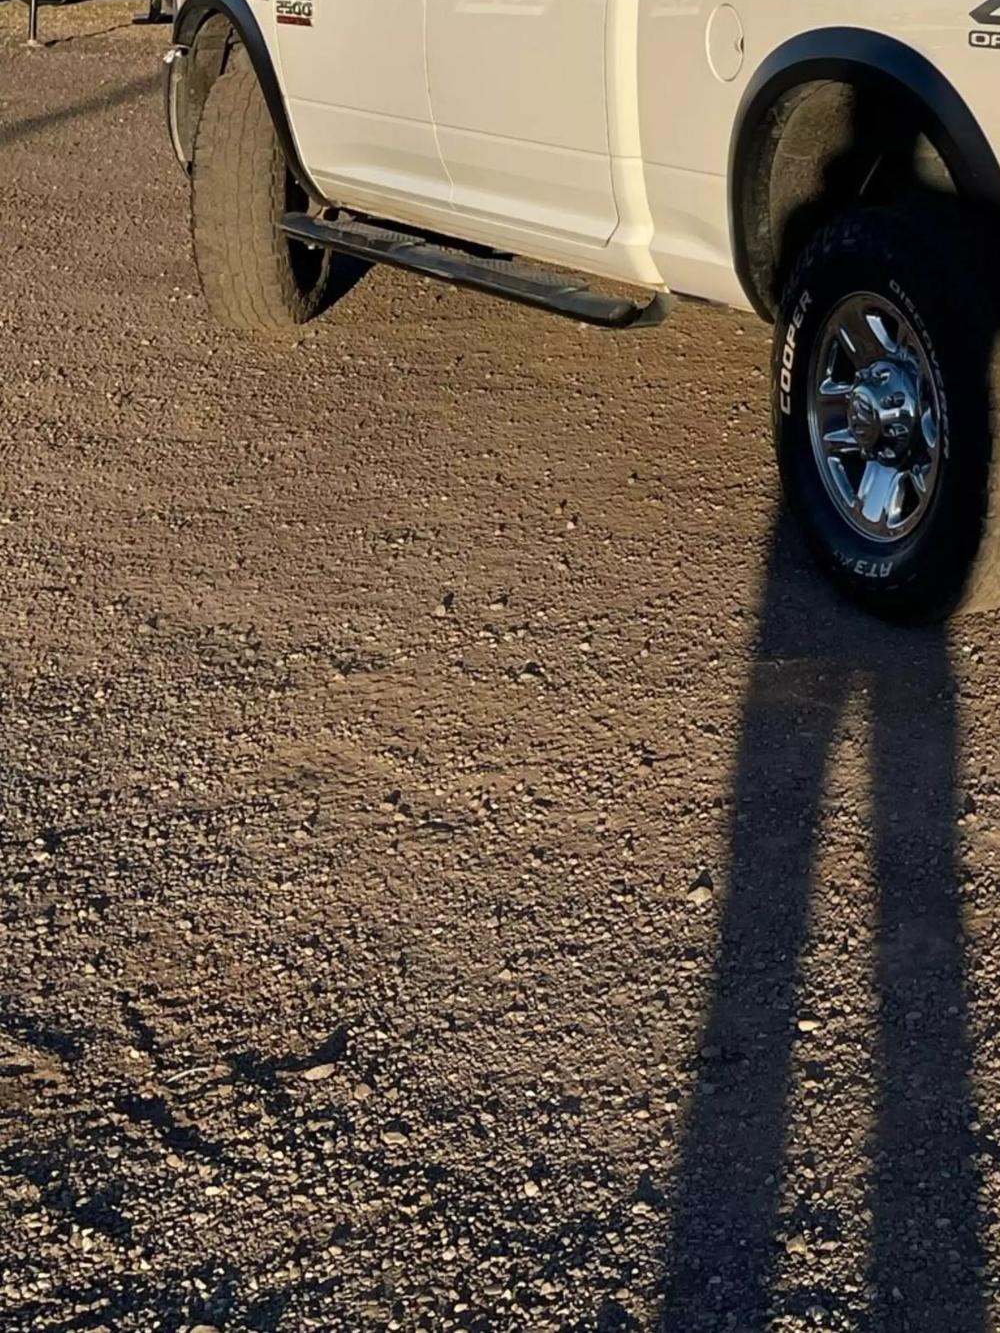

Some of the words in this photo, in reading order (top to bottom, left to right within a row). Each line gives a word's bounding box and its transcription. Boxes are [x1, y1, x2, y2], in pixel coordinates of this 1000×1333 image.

[276, 0, 313, 17] 2500
[780, 290, 812, 415] COOPER
[853, 559, 893, 578] AT3
